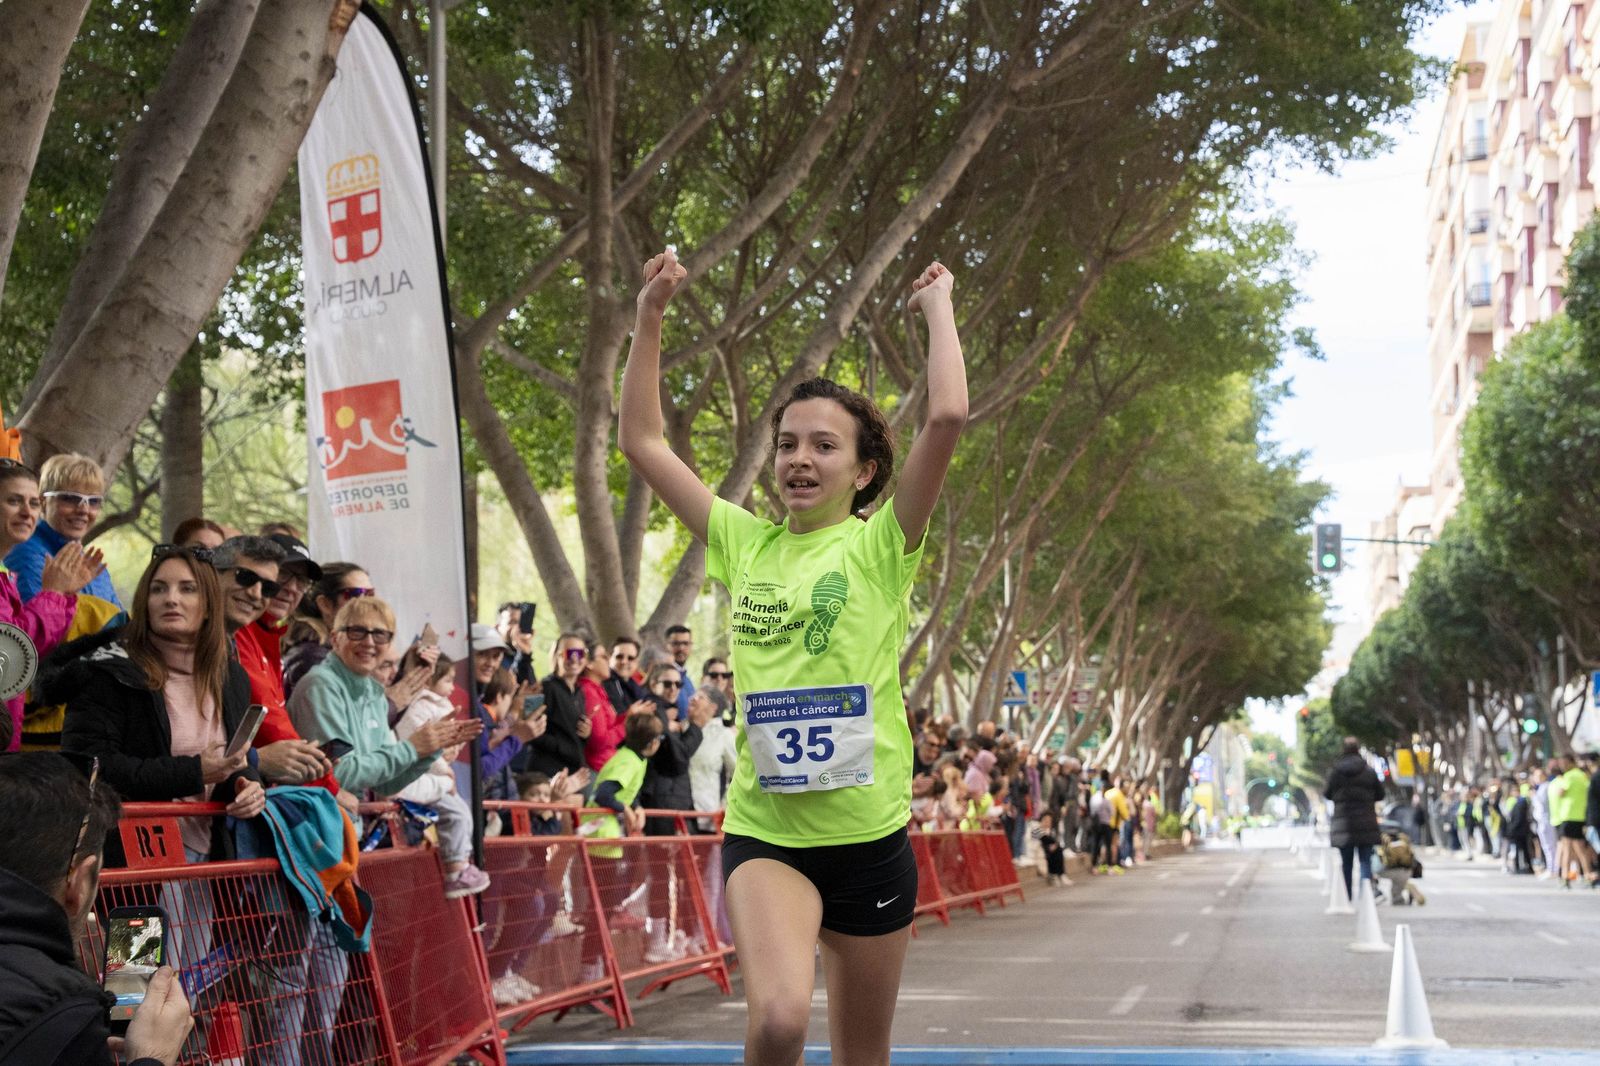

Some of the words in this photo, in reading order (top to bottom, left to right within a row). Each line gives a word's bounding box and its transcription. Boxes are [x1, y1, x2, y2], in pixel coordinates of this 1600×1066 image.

[742, 596, 789, 613] Almería
[741, 612, 782, 624] marcha
[760, 625, 771, 636] el
[774, 636, 792, 646] 2026
[758, 695, 795, 707] Almería
[796, 694, 811, 703] en
[756, 708, 787, 719] contra
[789, 707, 799, 715] el
[802, 705, 839, 715] cáncer
[776, 725, 834, 764] 35
